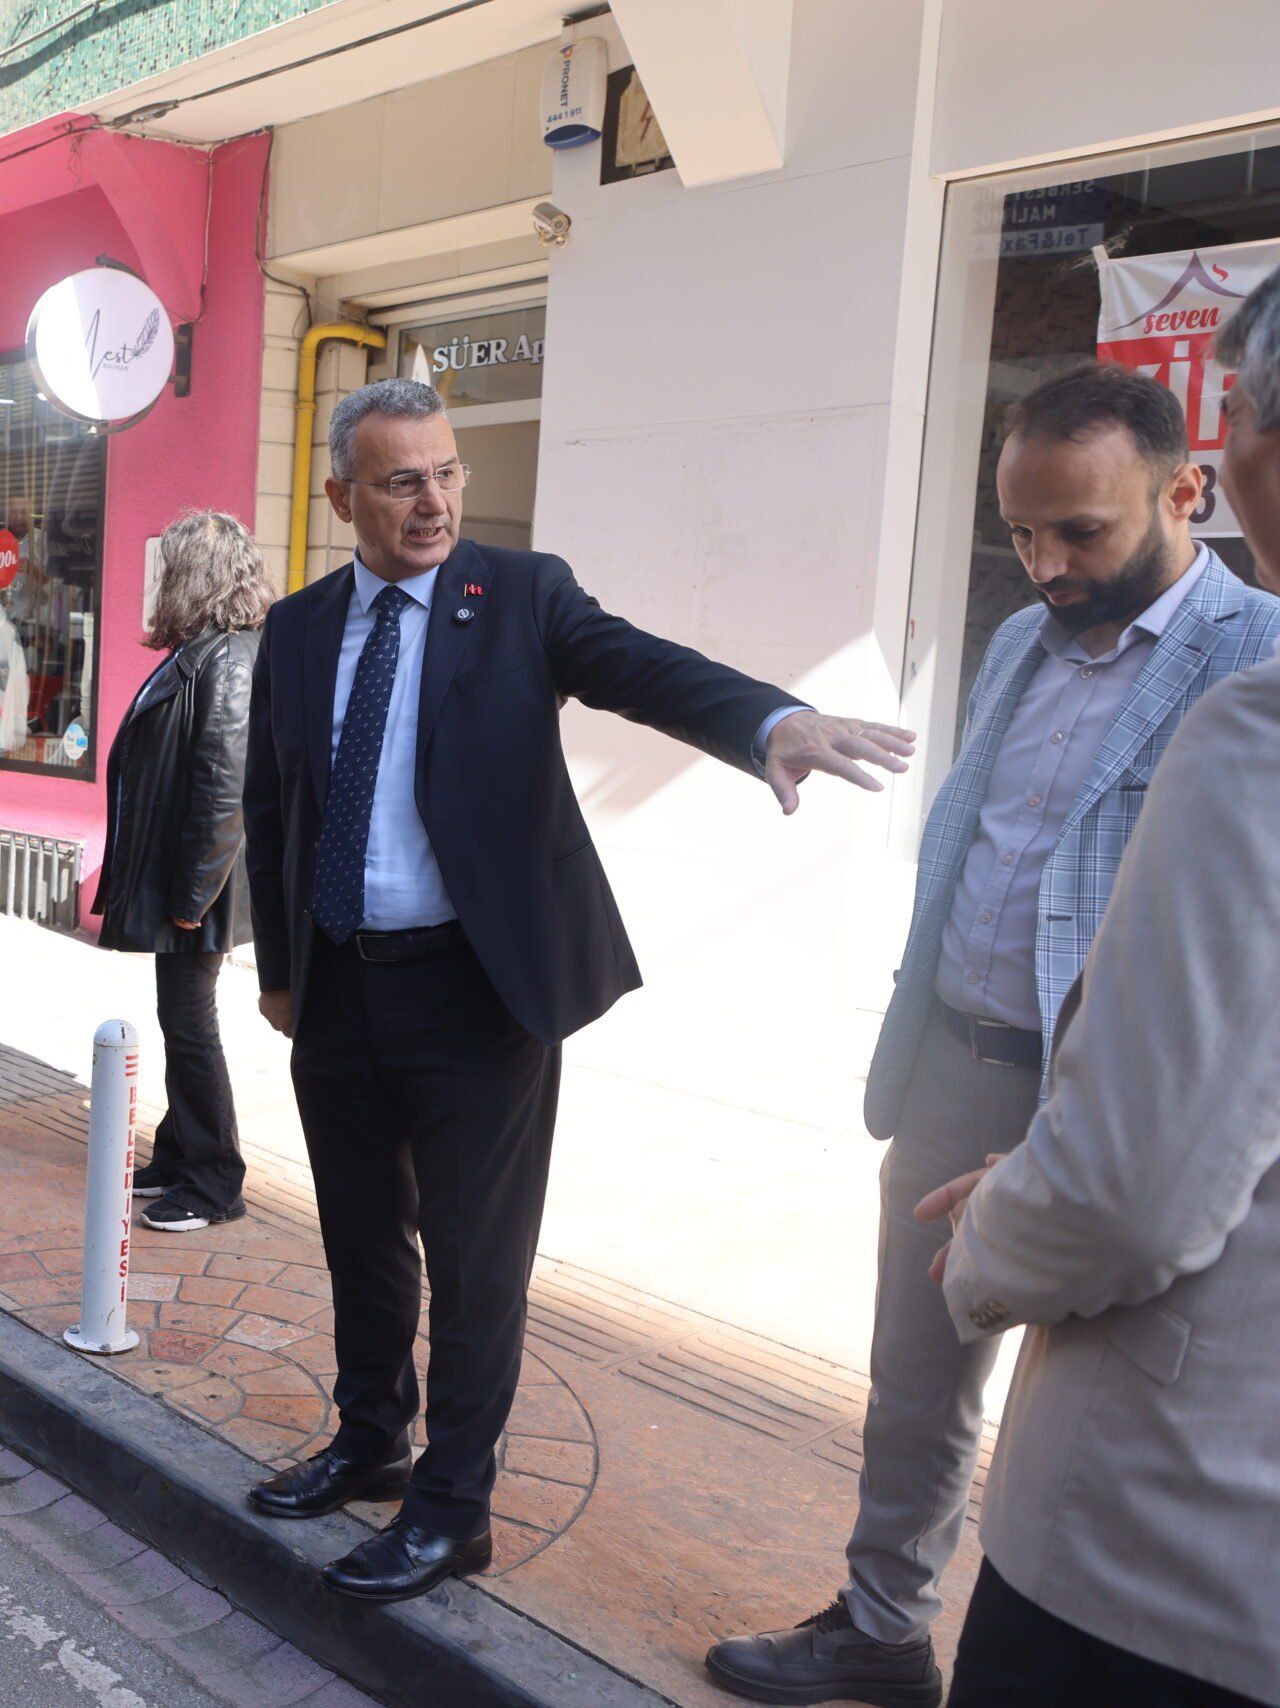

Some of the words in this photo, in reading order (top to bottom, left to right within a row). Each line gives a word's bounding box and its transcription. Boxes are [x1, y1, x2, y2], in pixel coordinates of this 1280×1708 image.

[561, 60, 571, 107] PRONET
[547, 112, 563, 122] 444
[1144, 306, 1221, 335] seven
[432, 335, 508, 373] SÜER
